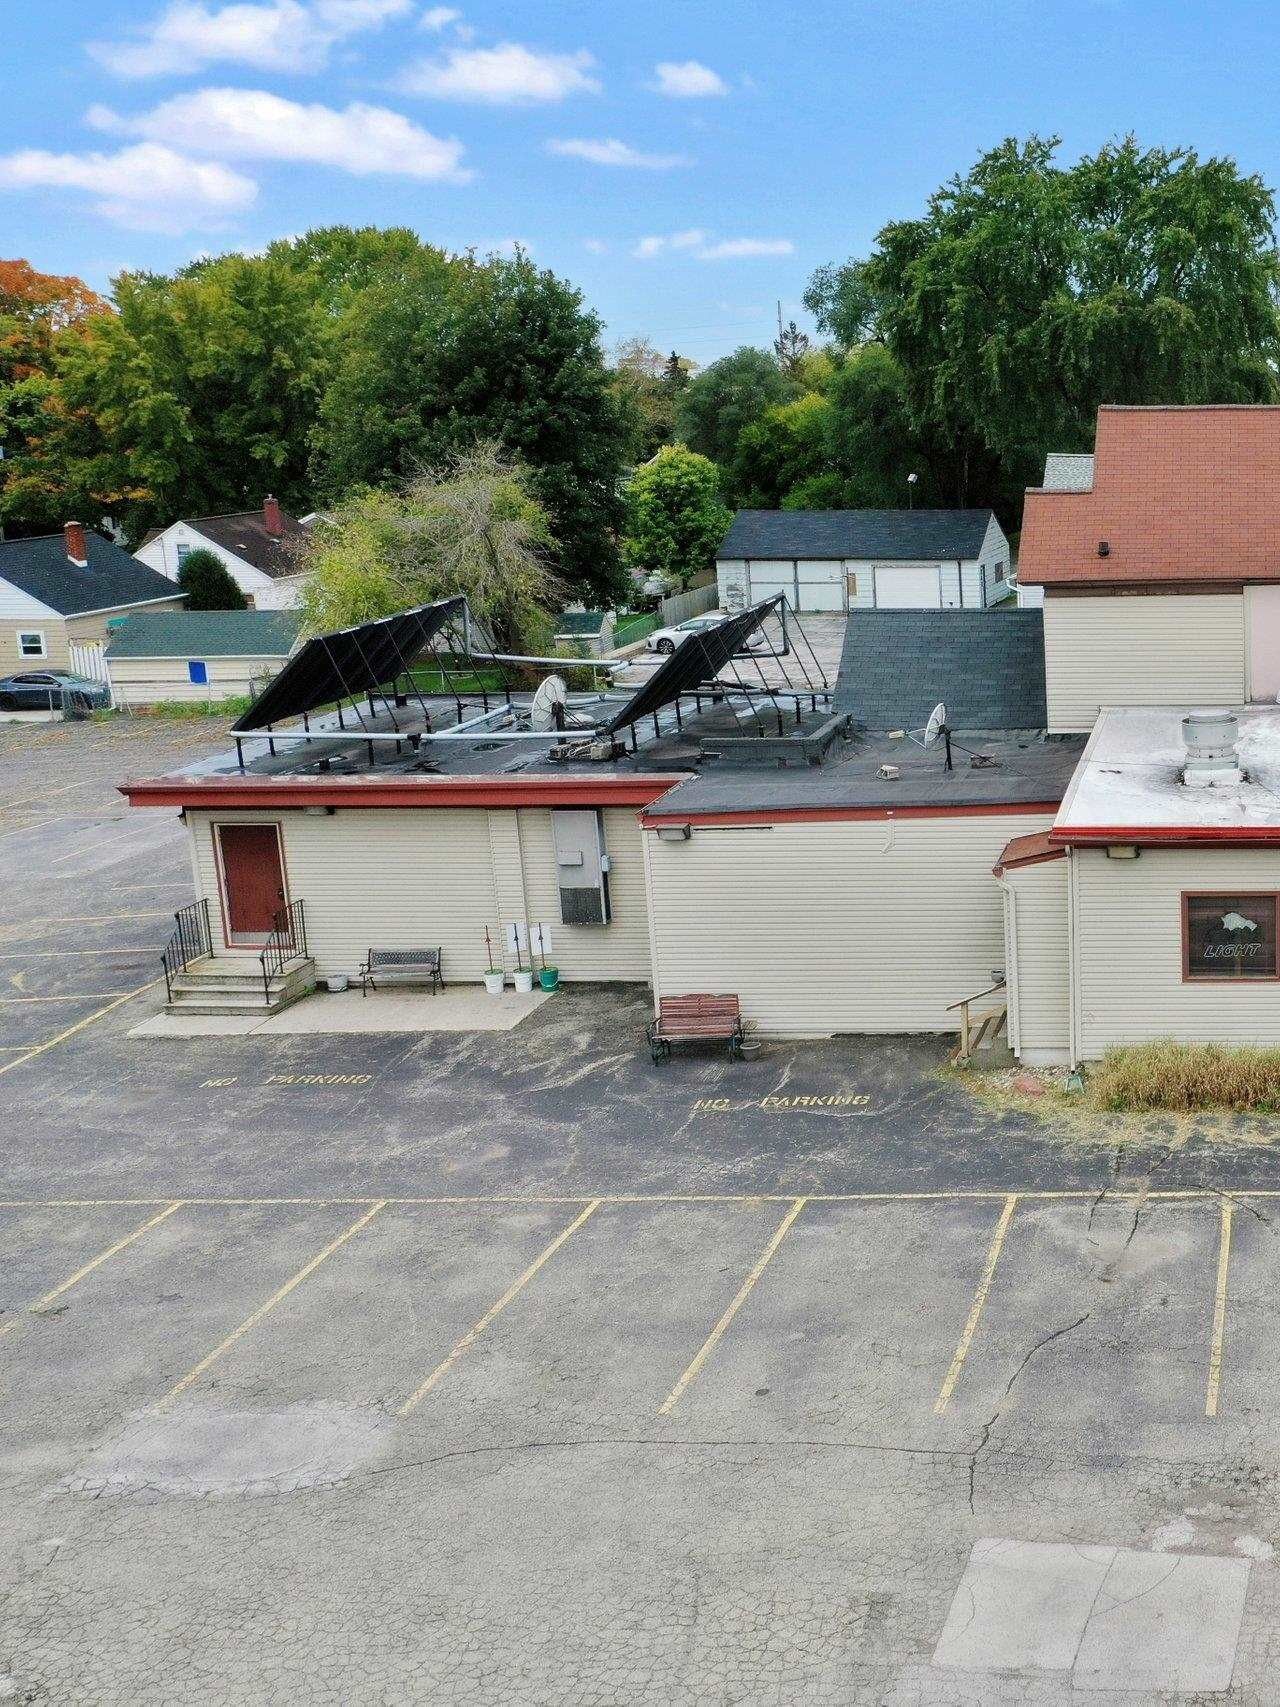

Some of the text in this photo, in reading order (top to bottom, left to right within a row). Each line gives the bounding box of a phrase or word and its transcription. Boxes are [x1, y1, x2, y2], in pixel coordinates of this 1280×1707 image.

[1203, 943, 1262, 958] LIGHT
[199, 1076, 238, 1088] NO
[692, 1095, 872, 1110] NO PARKING
